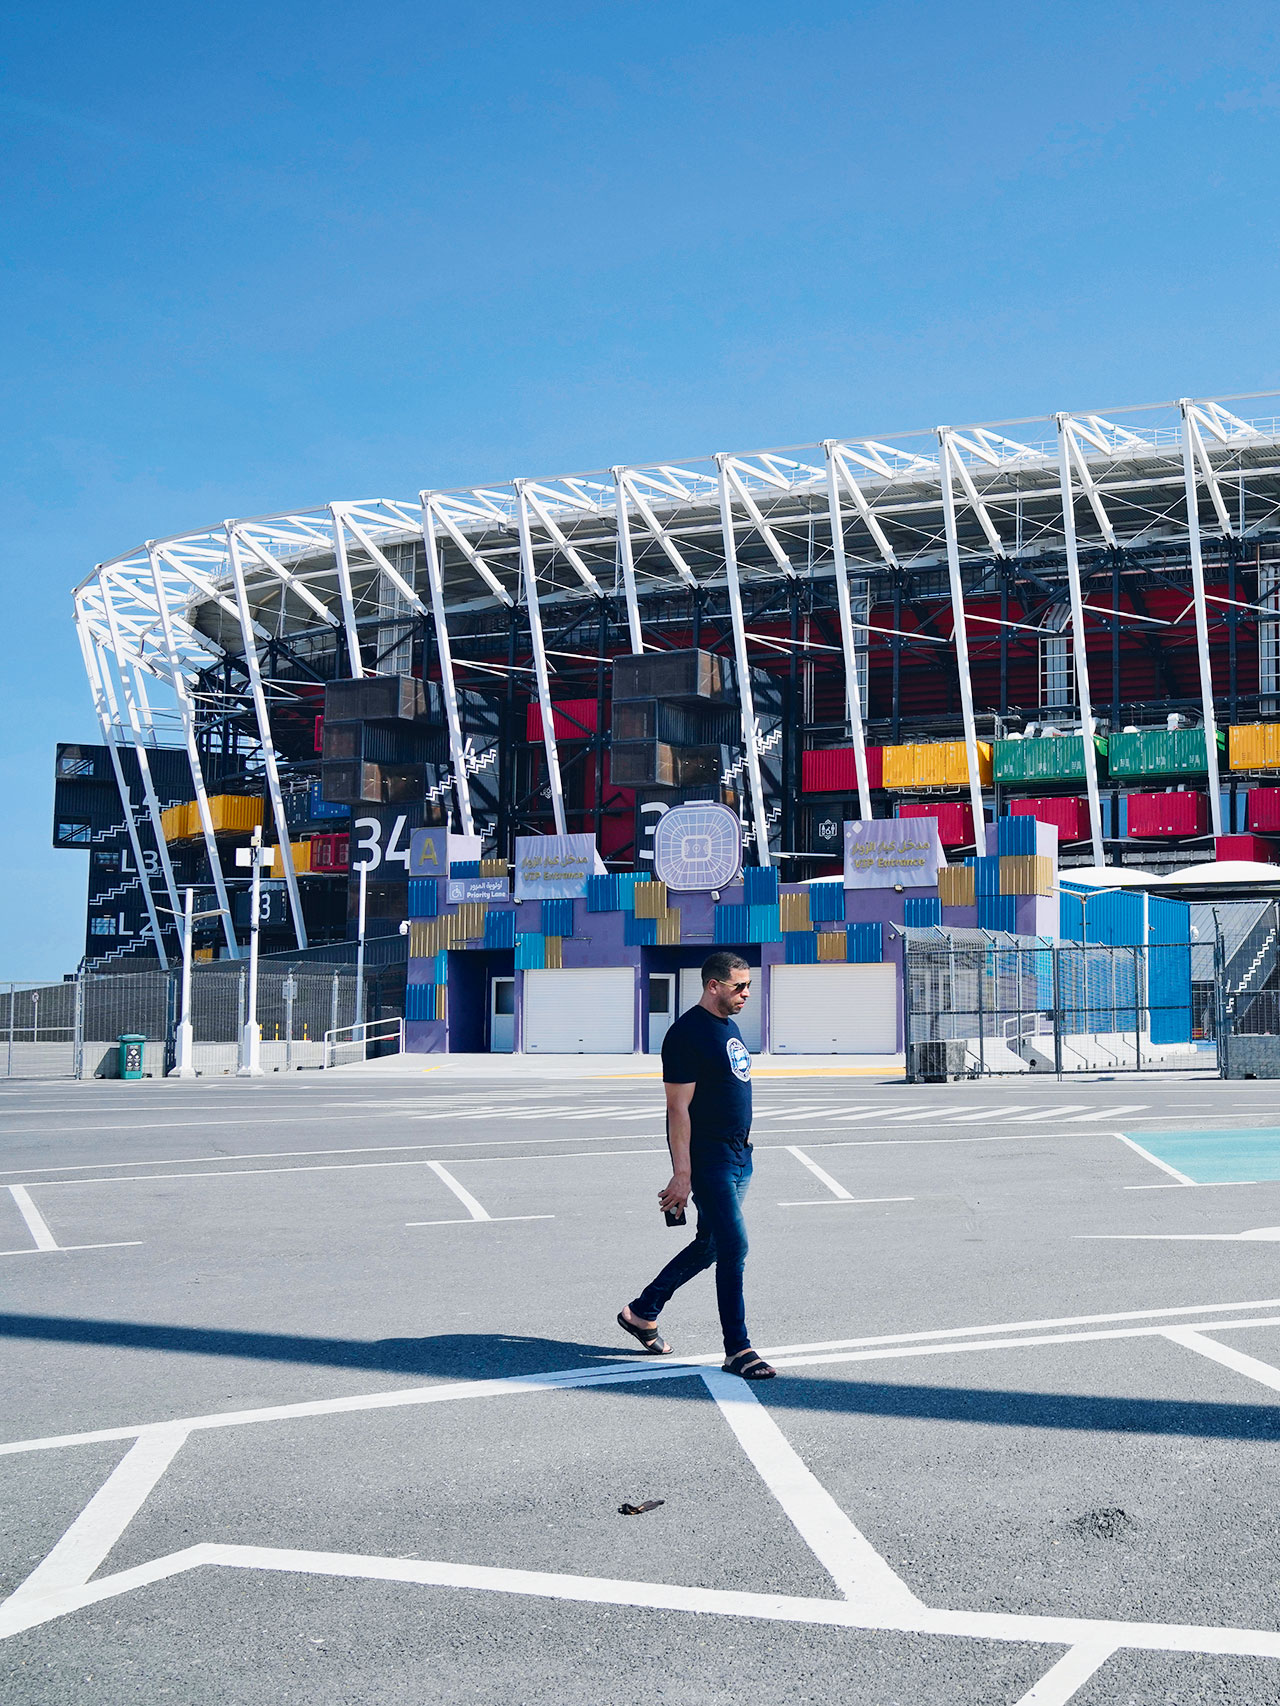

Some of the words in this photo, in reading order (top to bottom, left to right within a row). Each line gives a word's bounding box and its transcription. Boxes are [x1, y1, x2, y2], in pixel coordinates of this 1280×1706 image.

[352, 815, 410, 872] 34
[418, 838, 439, 866] A
[121, 849, 159, 875] L3
[878, 858, 926, 868] Entrance
[543, 871, 585, 880] Entrance
[467, 891, 490, 900] Priority
